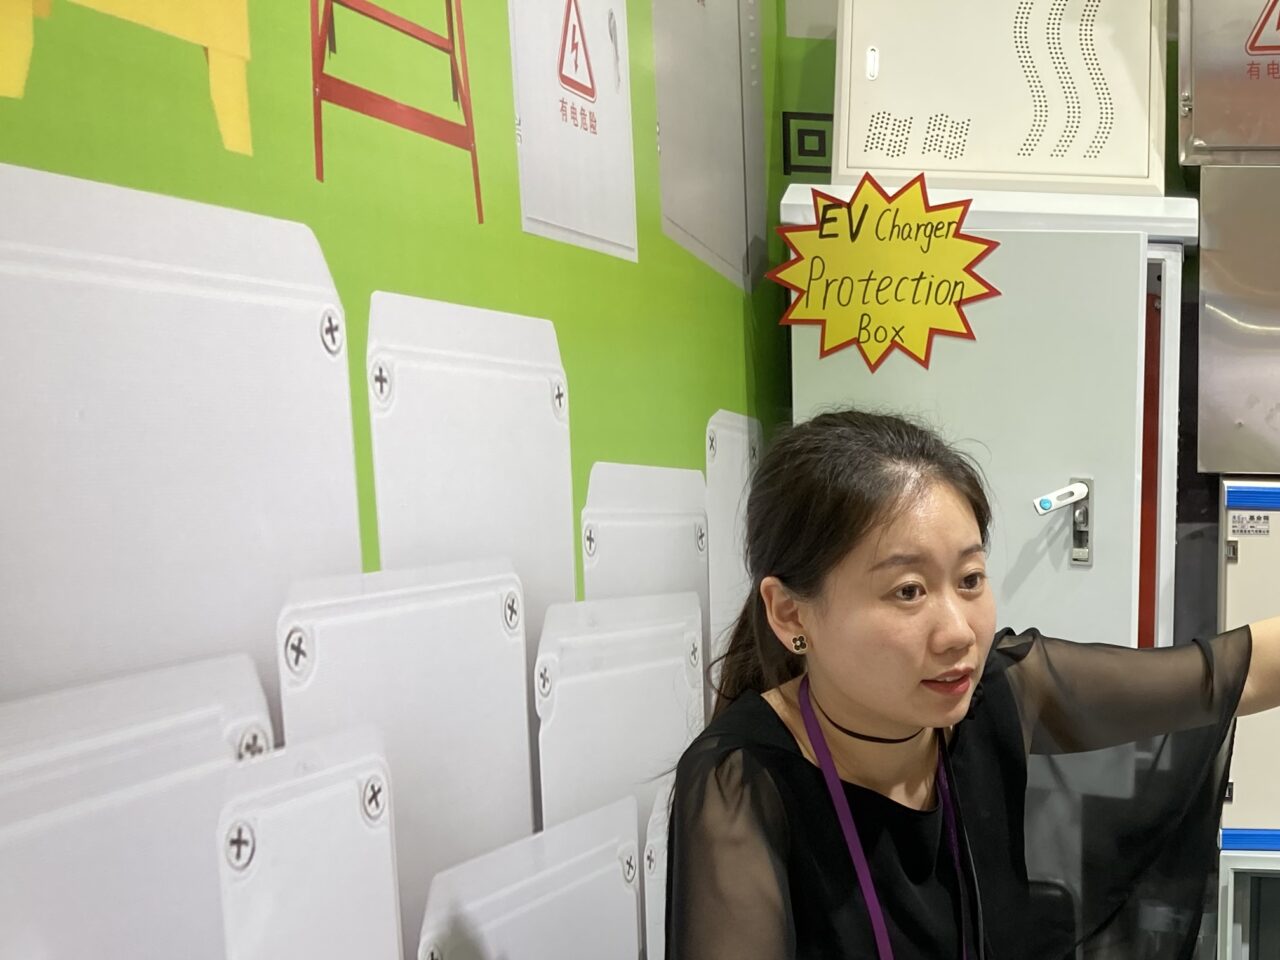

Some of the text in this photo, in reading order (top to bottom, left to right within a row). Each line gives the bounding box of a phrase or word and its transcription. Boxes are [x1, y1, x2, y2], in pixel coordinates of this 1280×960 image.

[558, 97, 598, 135] 有电危险
[818, 202, 958, 253] EV Charger
[804, 256, 965, 309] Protection
[857, 313, 906, 345] Box
